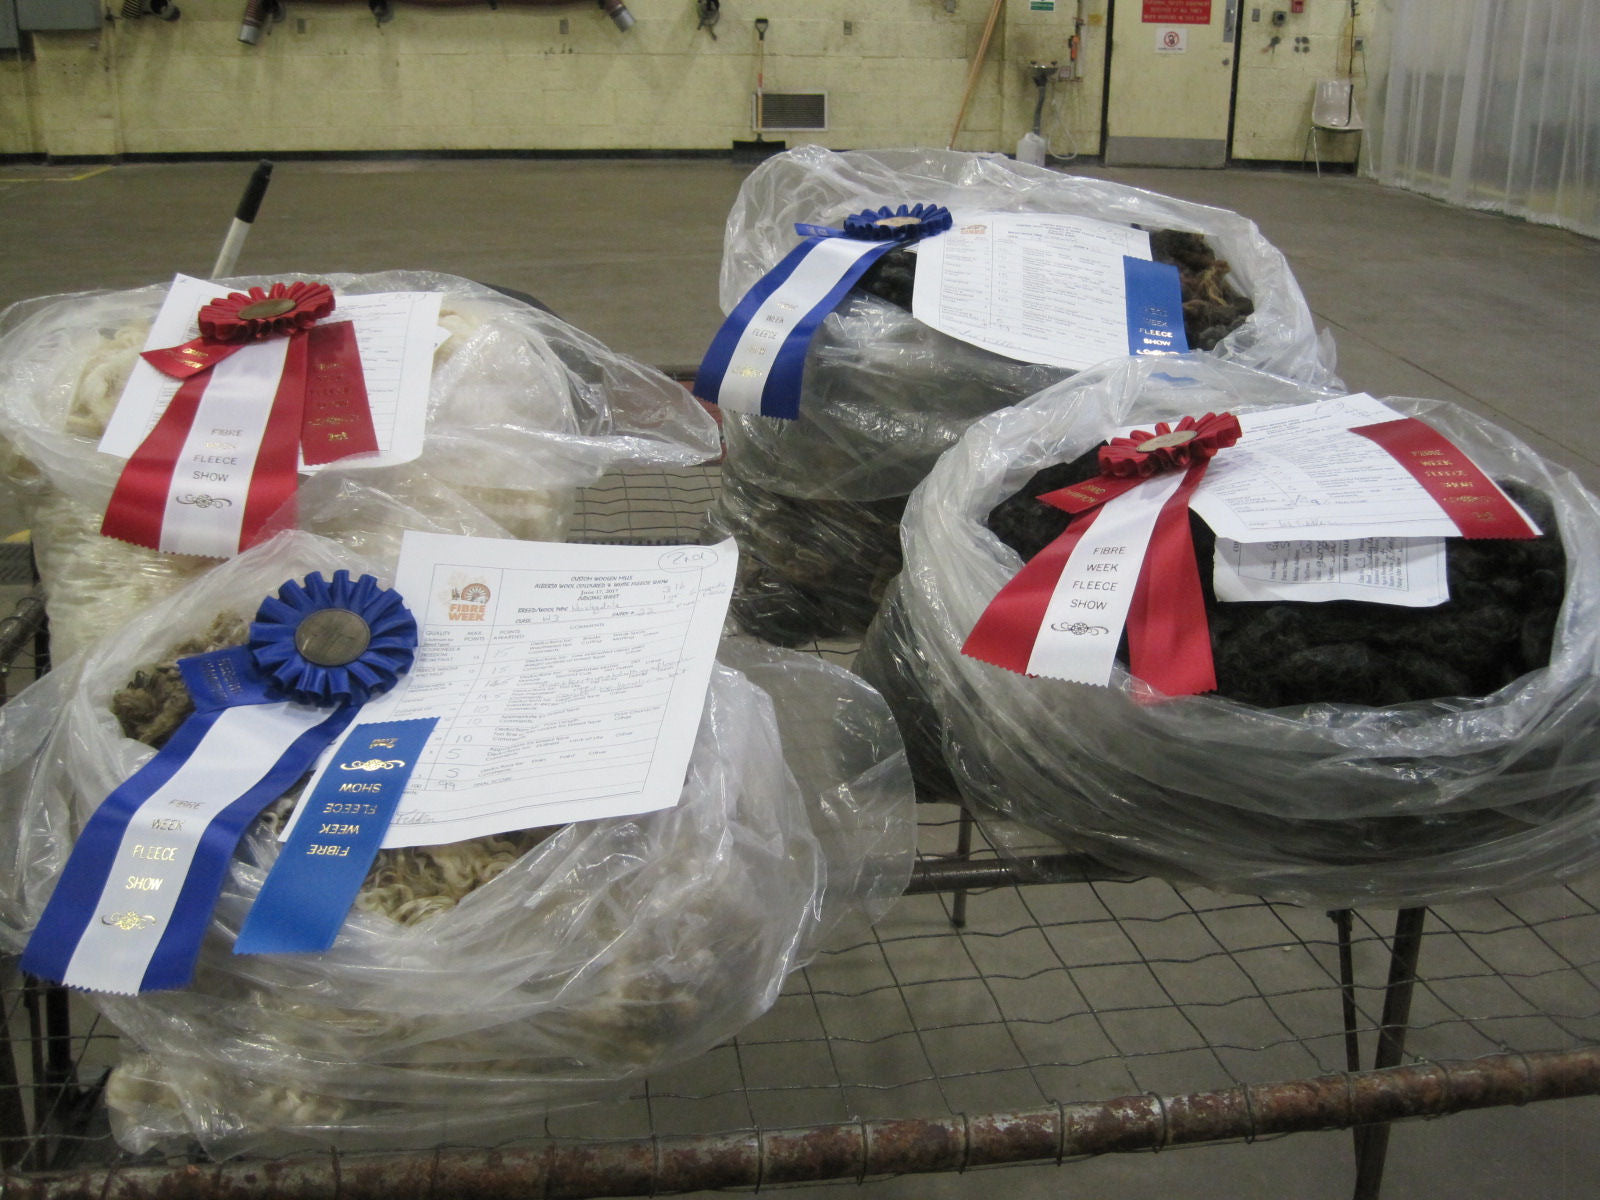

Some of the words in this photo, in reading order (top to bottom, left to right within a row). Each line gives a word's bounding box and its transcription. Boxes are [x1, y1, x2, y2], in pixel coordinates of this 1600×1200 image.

[1139, 327, 1173, 338] FLEECE
[1143, 337, 1171, 347] SHOW
[192, 454, 239, 465] FLEECE
[192, 470, 229, 482] SHOW
[1092, 546, 1127, 556] FIBRE
[1086, 563, 1119, 573] WEEK
[1072, 580, 1119, 592] FLEECE
[450, 603, 486, 613] FIBRE
[1069, 598, 1108, 611] SHOW
[448, 612, 486, 622] WEEK
[338, 783, 383, 793] SHOW
[322, 802, 378, 815] FLEECE
[151, 818, 184, 831] WEEK
[318, 823, 360, 835] WEEK
[131, 844, 179, 861] FLEECE
[306, 844, 351, 857] FIBRE
[125, 875, 164, 891] SHOW
